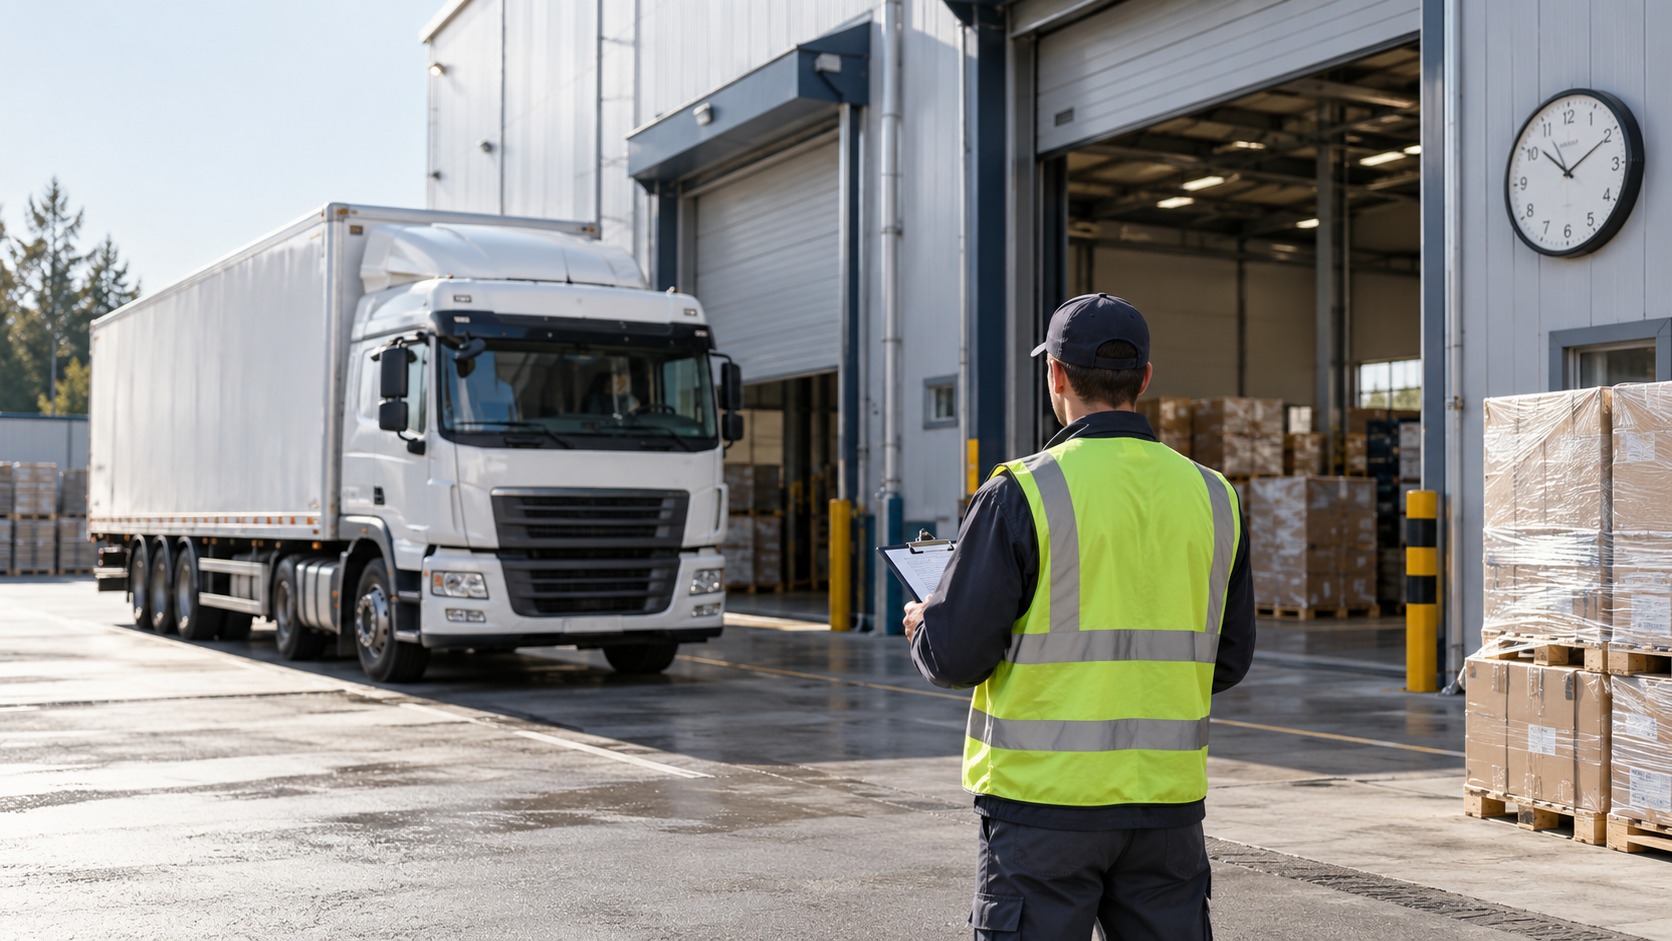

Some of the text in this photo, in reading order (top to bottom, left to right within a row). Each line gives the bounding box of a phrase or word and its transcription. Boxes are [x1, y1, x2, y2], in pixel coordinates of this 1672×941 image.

[1563, 110, 1575, 124] 12
[1589, 112, 1593, 126] 1
[1543, 122, 1551, 137] 11
[1604, 129, 1611, 143] 2
[1527, 147, 1538, 161] 10
[1612, 157, 1619, 171] 3
[1520, 177, 1527, 190] 9
[1603, 188, 1610, 201] 4
[1526, 203, 1534, 217] 8
[1587, 212, 1594, 226] 5
[1543, 220, 1550, 234] 7
[1564, 224, 1571, 238] 6
